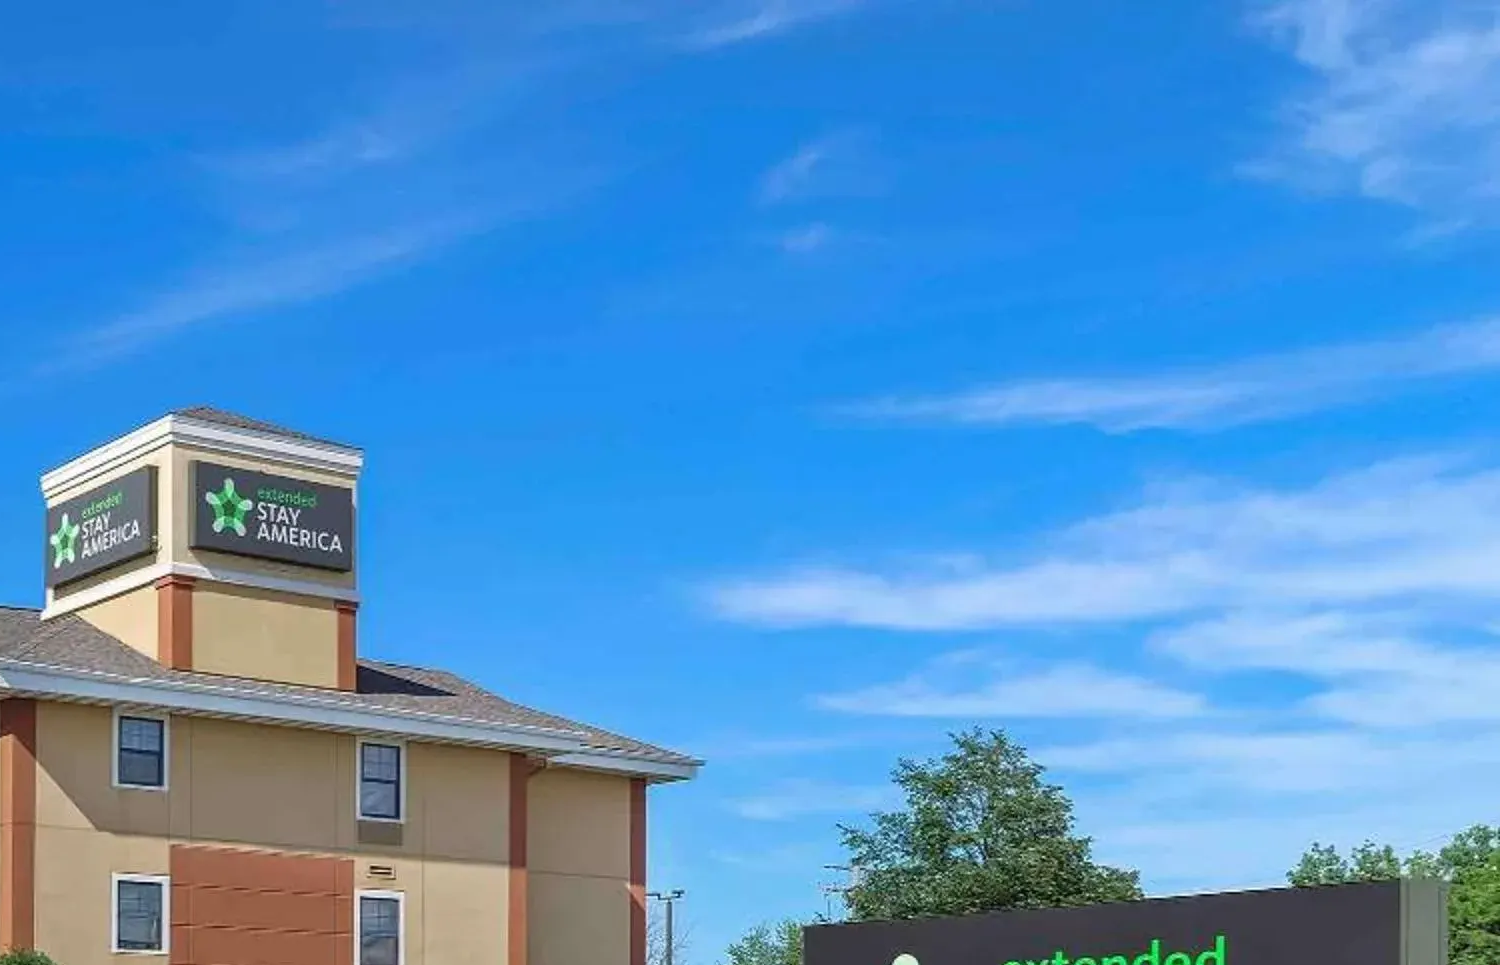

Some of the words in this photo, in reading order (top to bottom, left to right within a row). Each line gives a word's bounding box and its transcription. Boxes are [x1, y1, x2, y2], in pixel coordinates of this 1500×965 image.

[257, 487, 318, 507] extended
[81, 511, 111, 540] STAY
[257, 501, 301, 526] STAY
[81, 519, 141, 560] AMERICA
[257, 522, 343, 553] AMERICA
